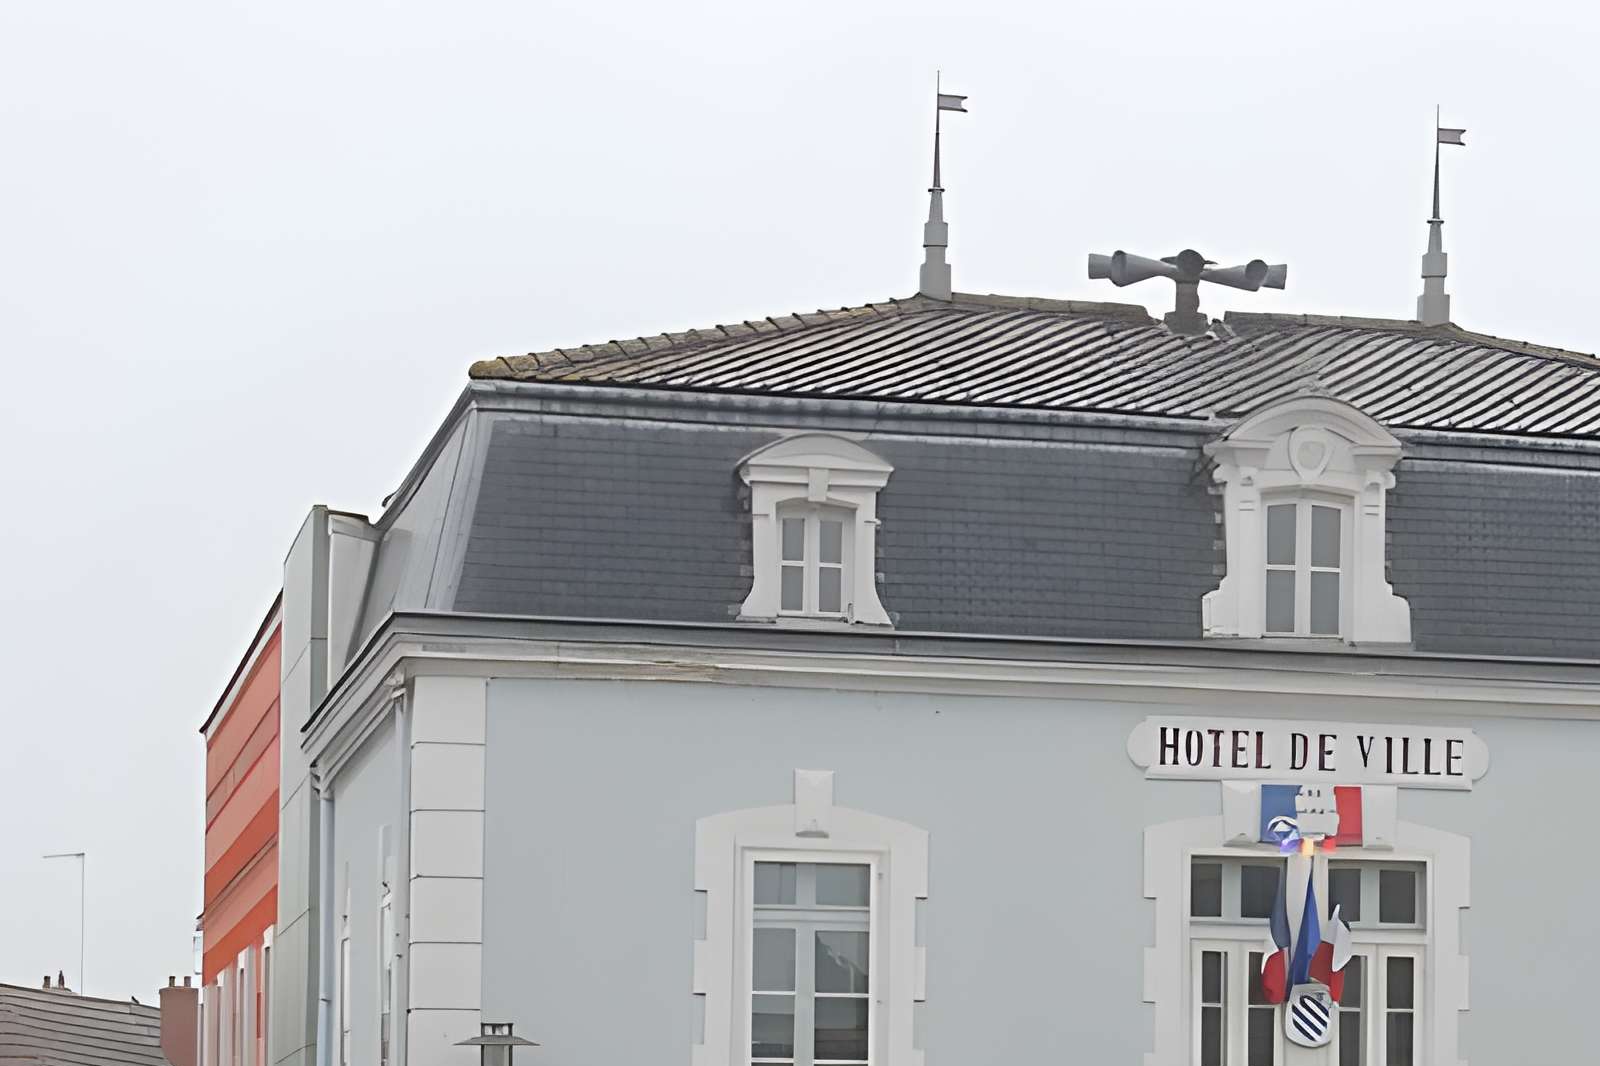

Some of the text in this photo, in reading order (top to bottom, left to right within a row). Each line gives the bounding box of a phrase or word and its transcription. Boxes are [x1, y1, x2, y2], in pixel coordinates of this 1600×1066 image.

[1158, 726, 1465, 777] HOTEL DE VILLE
